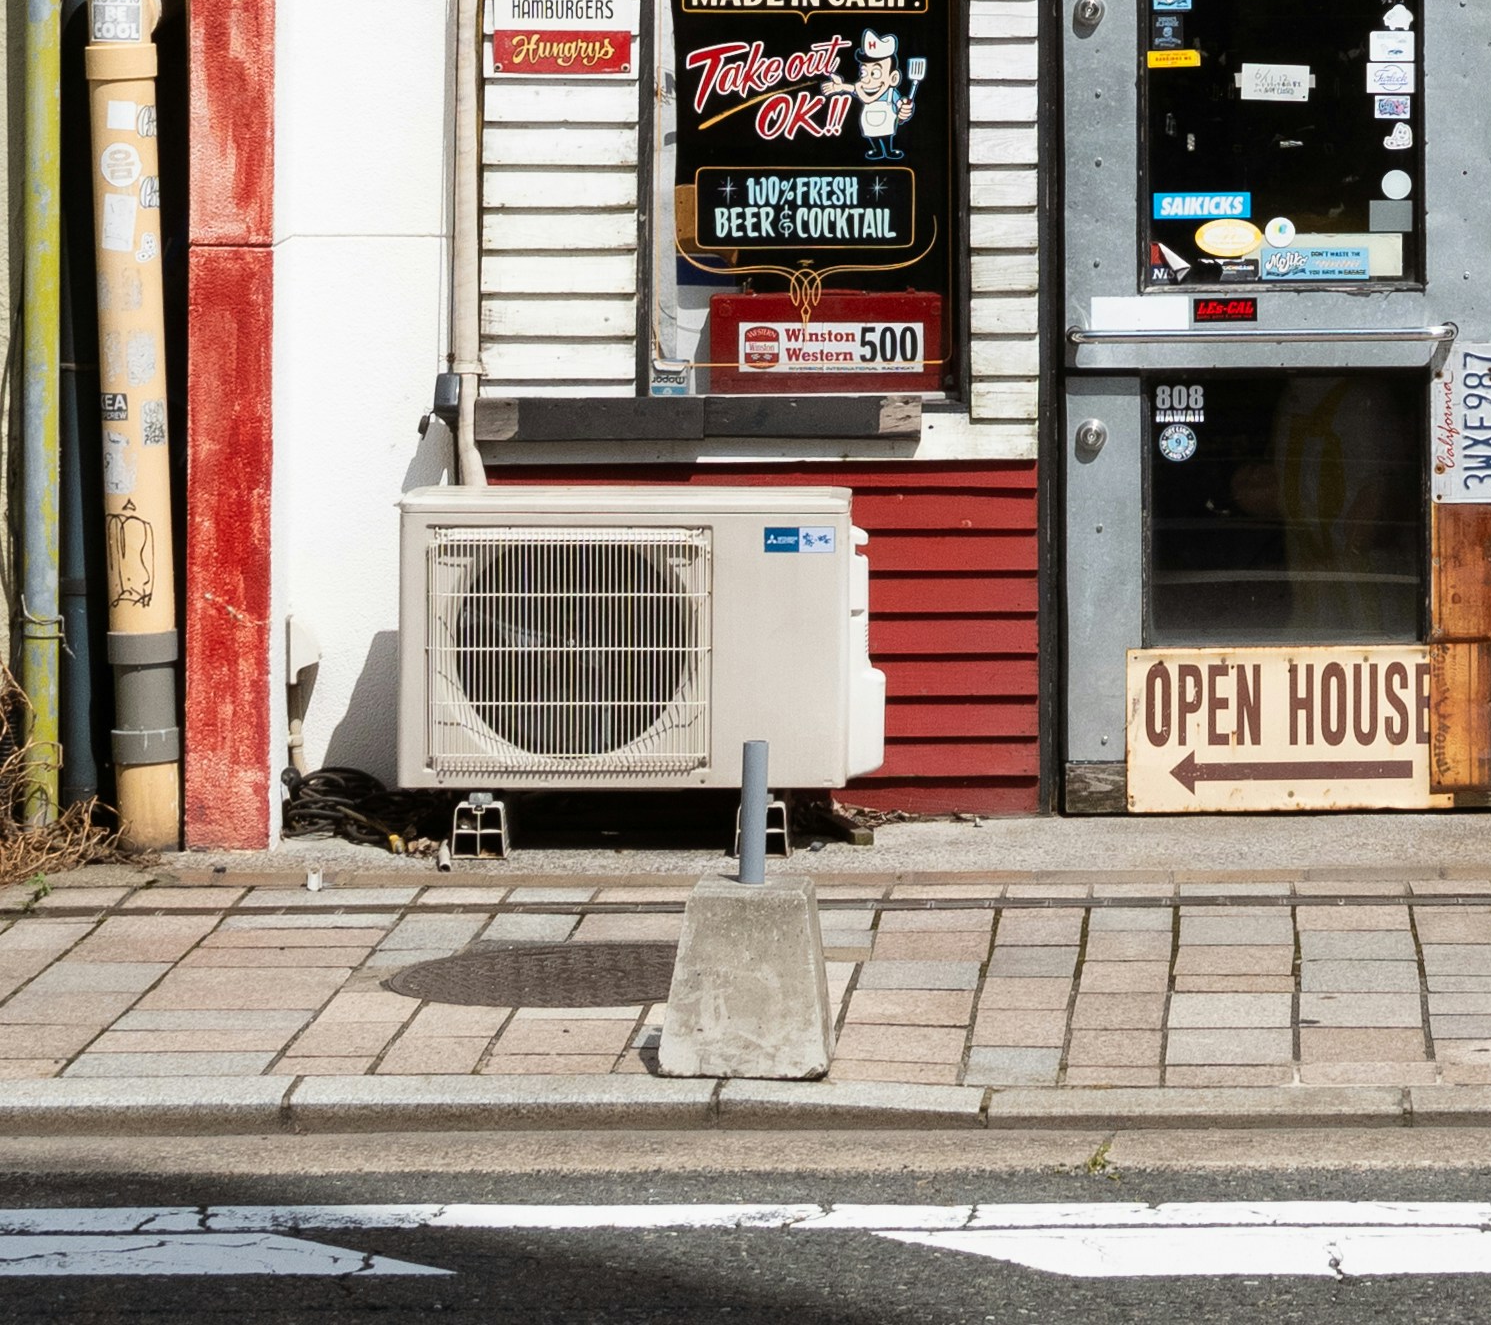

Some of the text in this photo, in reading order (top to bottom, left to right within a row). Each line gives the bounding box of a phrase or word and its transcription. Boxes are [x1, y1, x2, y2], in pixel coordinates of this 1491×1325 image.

[104, 5, 128, 22] BE
[511, 0, 615, 20] HAMBURGERS
[94, 21, 140, 39] COOL
[511, 33, 616, 67] Hungrys
[685, 43, 782, 115] Take
[787, 34, 852, 78] out
[755, 93, 851, 141] OK!!
[795, 176, 858, 206] FRESH
[1160, 195, 1245, 216] SAIKICKS
[714, 202, 897, 239] BEER & COCKTAIL
[783, 325, 919, 363] Winston 500
[785, 347, 855, 362] Western
[1155, 384, 1205, 409] 808
[1155, 409, 1205, 423] HAWAII
[1435, 371, 1461, 470] California
[1175, 438, 1182, 447] 9
[1144, 661, 1431, 748] OPEN HOUSE
